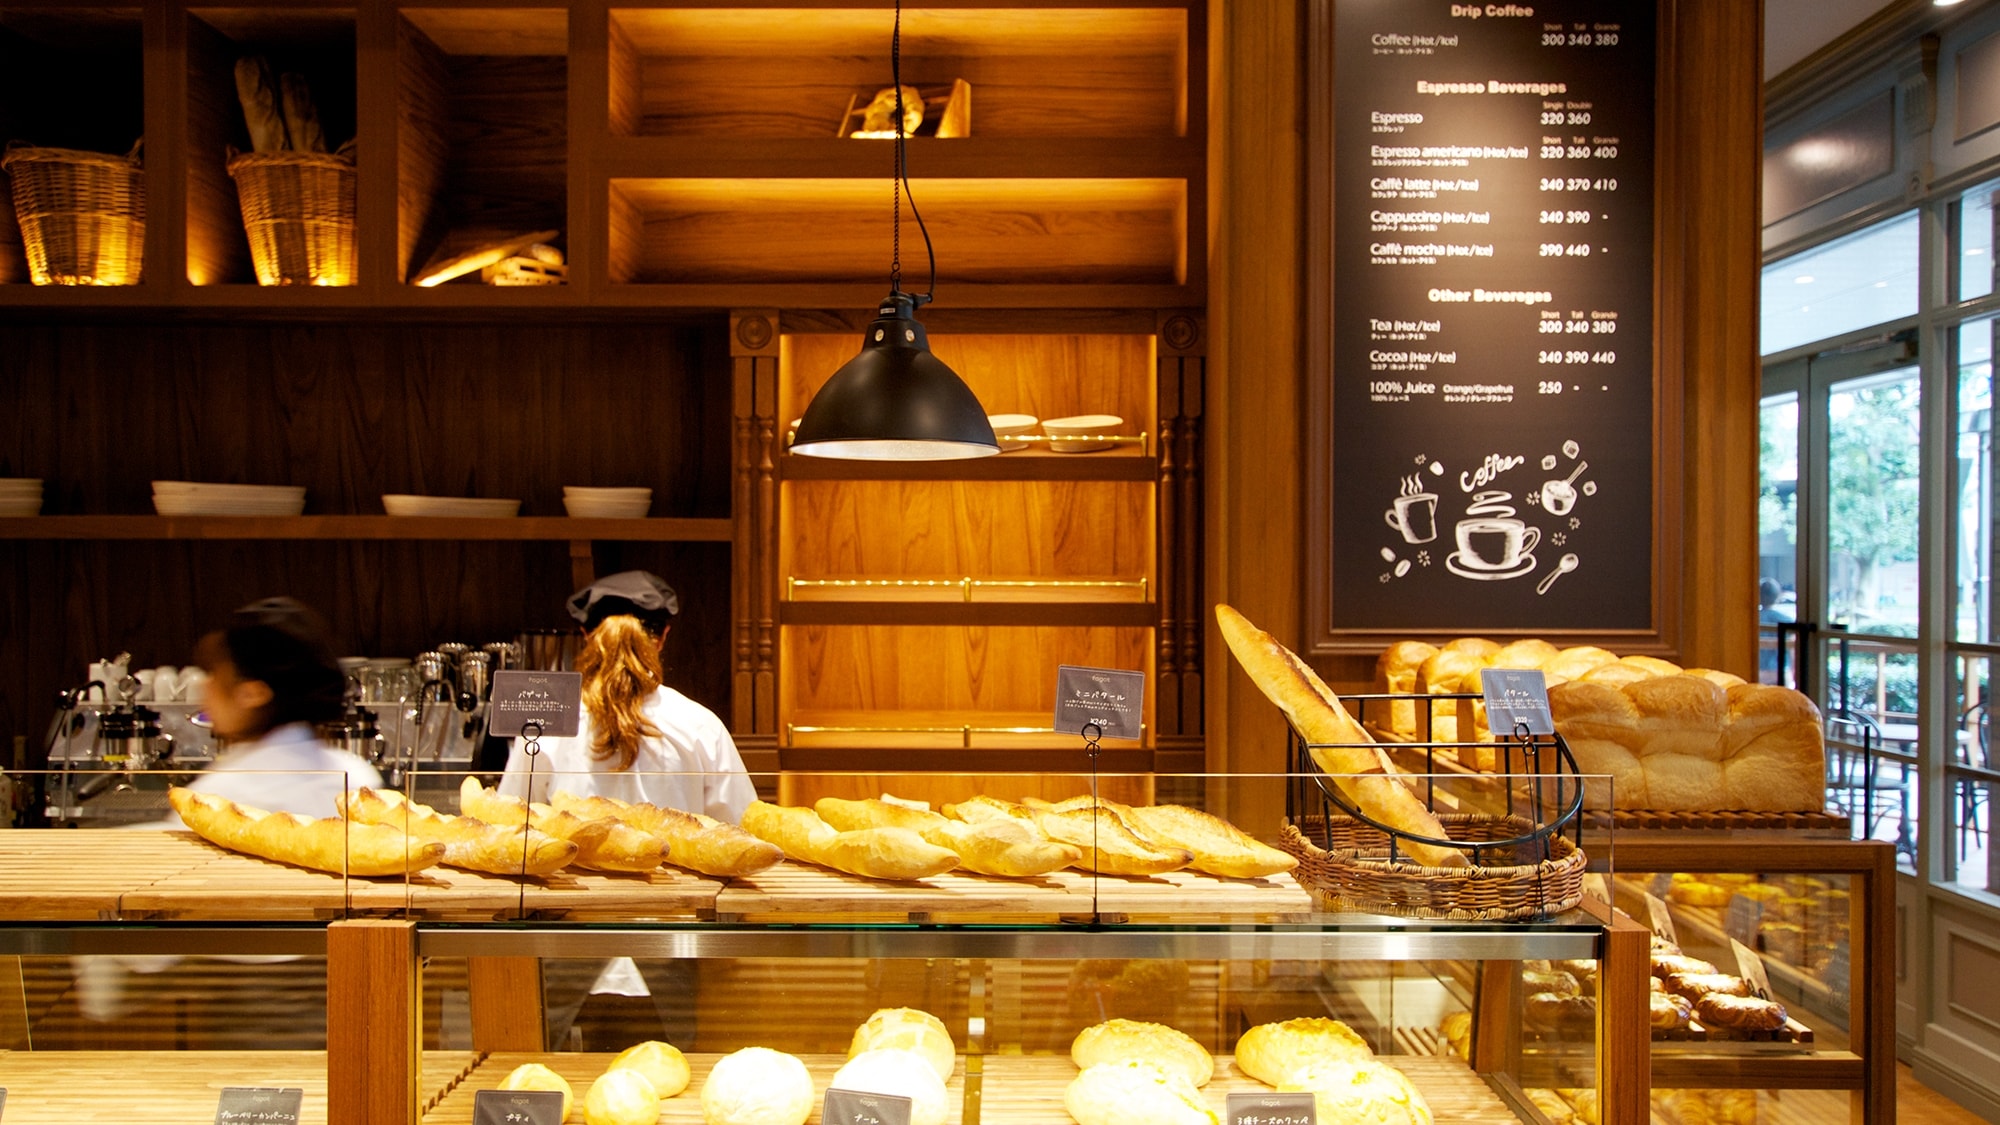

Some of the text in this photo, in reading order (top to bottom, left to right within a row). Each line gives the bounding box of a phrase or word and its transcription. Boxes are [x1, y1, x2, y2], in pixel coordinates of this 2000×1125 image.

[1451, 4, 1534, 20] Drip Coffee
[1372, 33, 1411, 46] Coffee
[1541, 33, 1565, 46] 300
[1568, 33, 1592, 46] 340
[1595, 33, 1618, 46] 380
[1417, 81, 1567, 97] Espresso Beverages
[1371, 111, 1591, 126] Espresso 320 360
[1542, 136, 1562, 144] Short
[1371, 145, 1420, 160] Espresso
[1421, 145, 1482, 158] americano
[1540, 146, 1565, 159] 320
[1567, 146, 1591, 159] 360
[1594, 146, 1618, 159] 400
[1404, 178, 1431, 190] latte
[1539, 178, 1563, 191] 340
[1566, 178, 1591, 191] 370
[1593, 178, 1617, 191] 410
[1370, 210, 1442, 225] Cappuccino
[1539, 211, 1563, 224] 340
[1566, 211, 1590, 224] 390
[1403, 243, 1445, 256] mocha
[1539, 244, 1563, 257] 390
[1565, 244, 1590, 257] 440
[1428, 289, 1471, 303] Other
[1540, 311, 1560, 319] Short
[1571, 311, 1583, 319] Tall
[1370, 319, 1392, 332] Tea
[1539, 321, 1563, 334] 300
[1565, 321, 1589, 334] 340
[1592, 321, 1616, 334] 380
[1369, 350, 1408, 363] Cocoa
[1539, 351, 1563, 364] 340
[1565, 351, 1589, 364] 390
[1592, 351, 1616, 364] 440
[1369, 381, 1402, 394] 100%
[1404, 381, 1435, 394] Juice
[1539, 381, 1562, 394] 250
